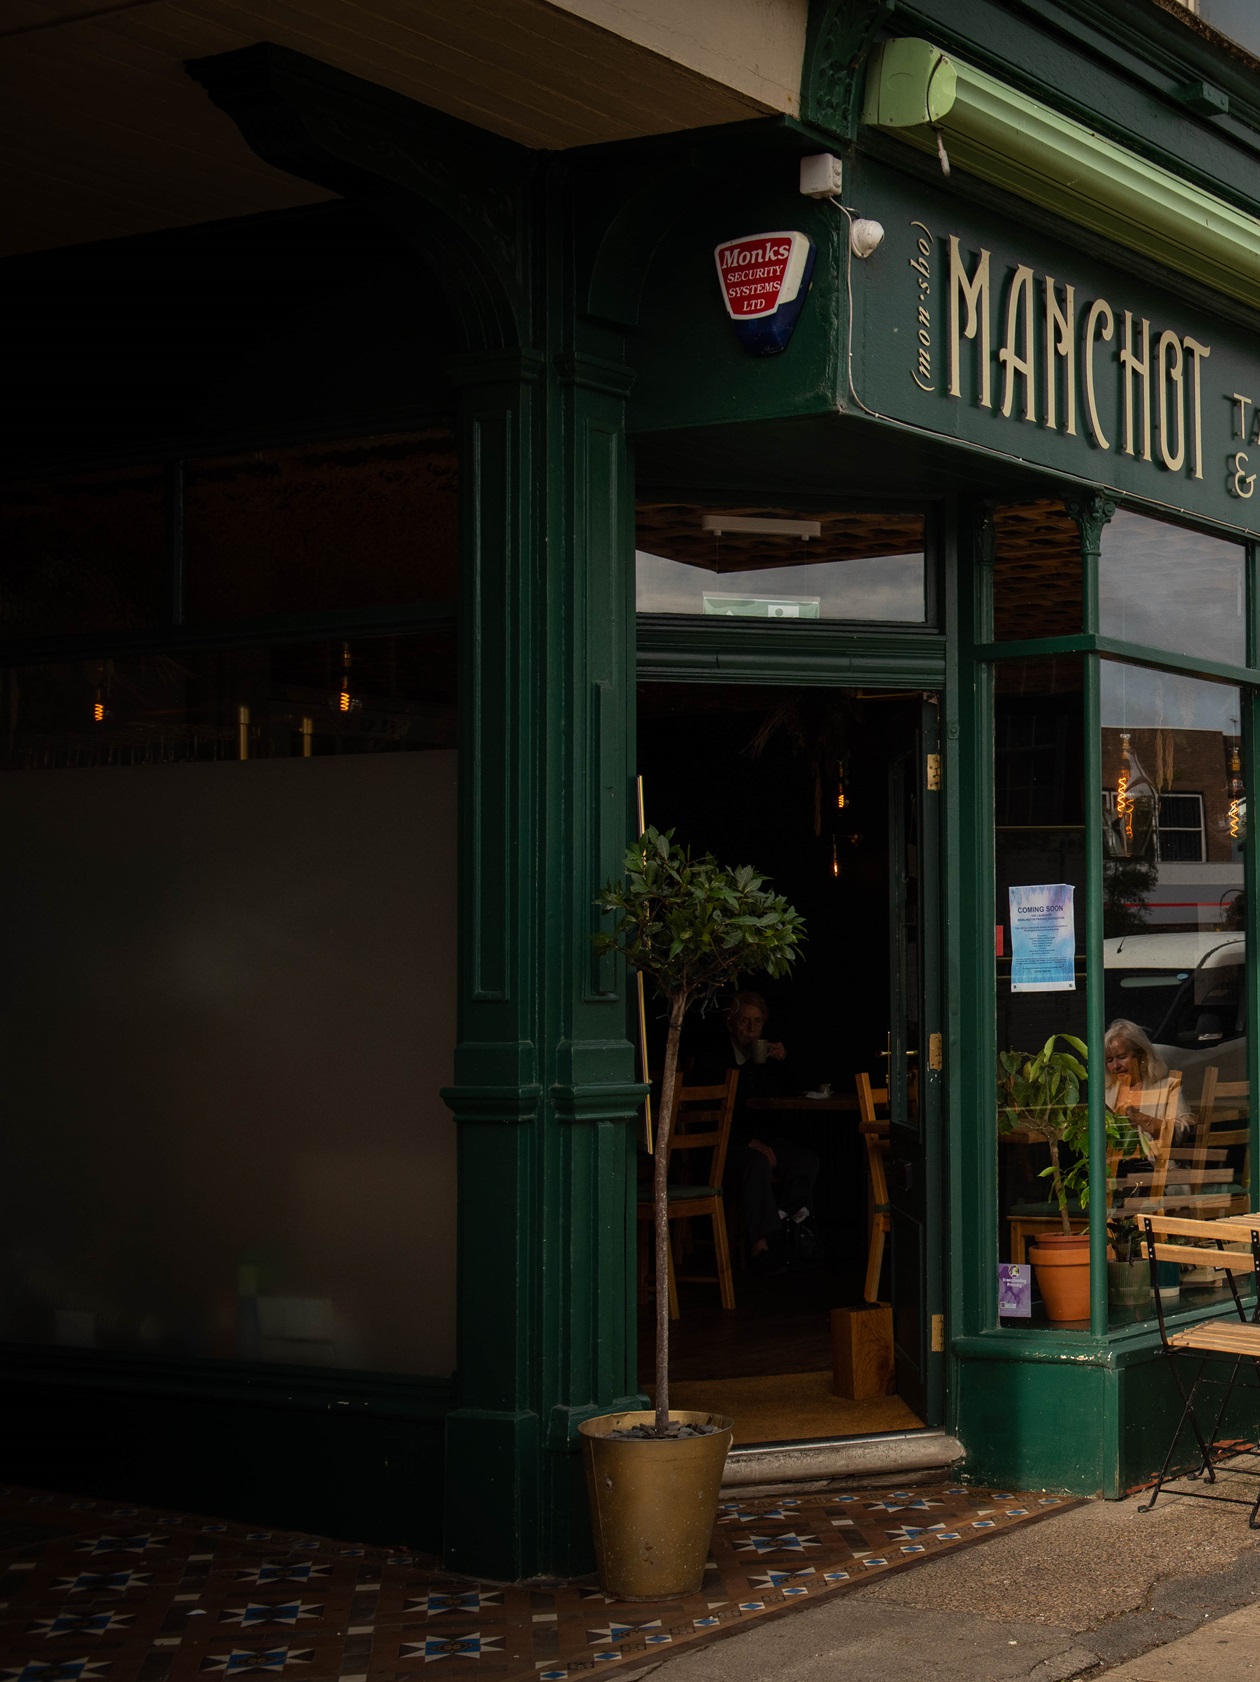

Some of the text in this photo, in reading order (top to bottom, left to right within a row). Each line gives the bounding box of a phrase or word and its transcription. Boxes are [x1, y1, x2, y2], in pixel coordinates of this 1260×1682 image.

[721, 242, 790, 269] Monks
[727, 265, 784, 283] SECURITY
[728, 281, 781, 298] SYSTEMS
[742, 298, 766, 312] LTD
[947, 234, 1211, 481] MANCHOT
[1233, 451, 1258, 500] &
[1017, 904, 1064, 914] COMING SOON
